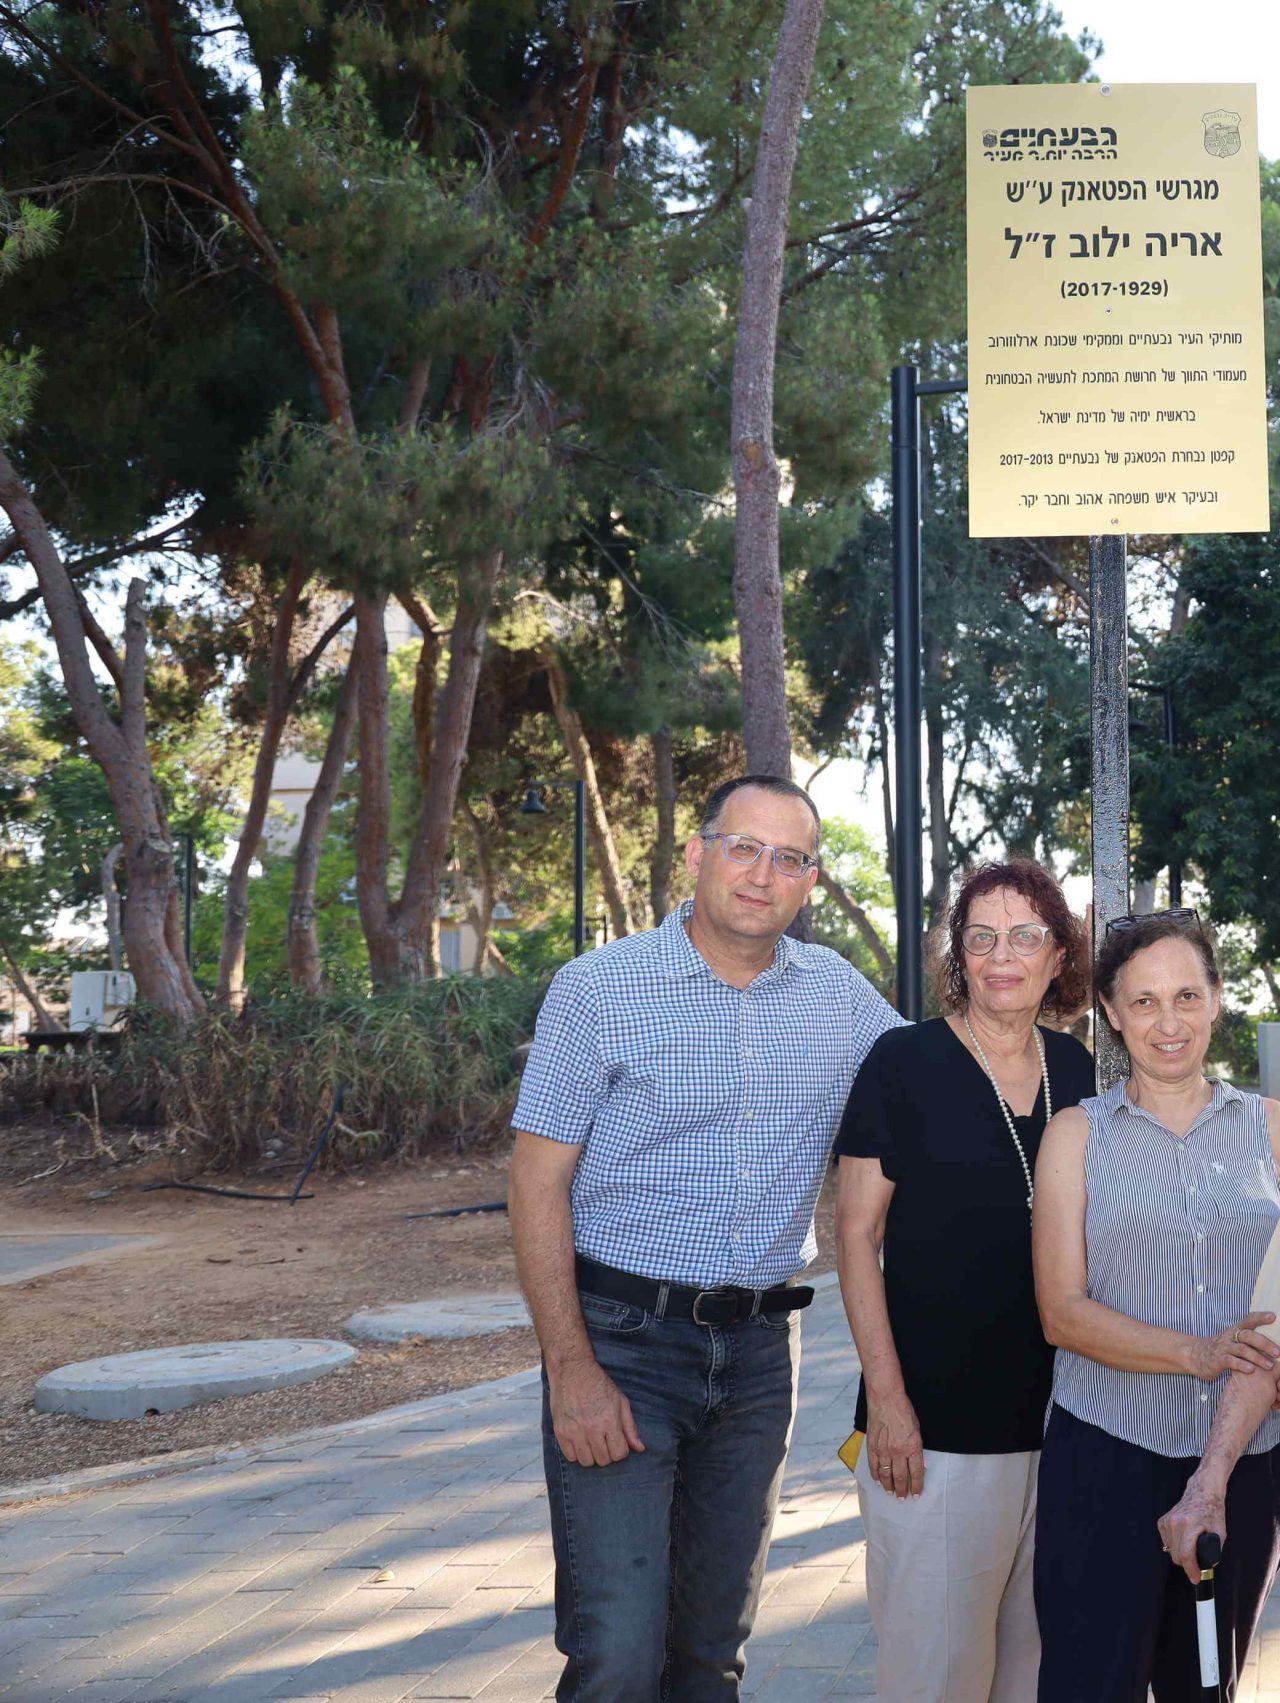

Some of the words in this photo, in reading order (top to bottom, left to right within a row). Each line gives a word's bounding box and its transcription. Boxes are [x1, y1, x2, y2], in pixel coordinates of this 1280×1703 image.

[999, 126, 1118, 148] גבעתיים
[1061, 179, 1148, 208] הפטאנק
[1155, 178, 1220, 201] מגרשי
[1069, 225, 1131, 259] ילוב
[1145, 231, 1223, 257] אריה
[1060, 279, 1169, 300] (2017-1929)
[987, 333, 1039, 349] ארלוזורוב
[1044, 334, 1078, 348] שכונת
[1082, 334, 1124, 349] וממקימי
[1128, 333, 1173, 347] גבעתיים
[1177, 333, 1204, 346] העיר
[1209, 332, 1243, 348] מותיקי
[985, 373, 1033, 387] הבטחונית
[1037, 369, 1077, 385] לתעשיה
[1081, 371, 1120, 385] המתכת
[1124, 370, 1158, 384] חרושת
[1161, 368, 1177, 383] של
[1180, 370, 1209, 385] התווך
[1213, 370, 1248, 383] מעמודי
[1037, 409, 1071, 425] ישראל.
[1076, 411, 1106, 425] מדינת
[1110, 408, 1126, 424] של
[1130, 410, 1152, 423] ימיה
[1155, 410, 1197, 423] בראשית
[999, 453, 1054, 467] 2017-2013
[1058, 452, 1100, 466] גבעתיים
[1104, 449, 1120, 465] של
[1124, 451, 1166, 467] הפטאנק
[1171, 450, 1207, 464] נבחרת
[1210, 450, 1236, 465] קפטן
[1018, 494, 1039, 509] יקר.
[1044, 494, 1071, 507] וחבר
[1075, 493, 1104, 506] אהוב
[1109, 492, 1151, 506] משפחה
[1155, 491, 1177, 505] איש
[1182, 491, 1219, 505] ובעיקר
